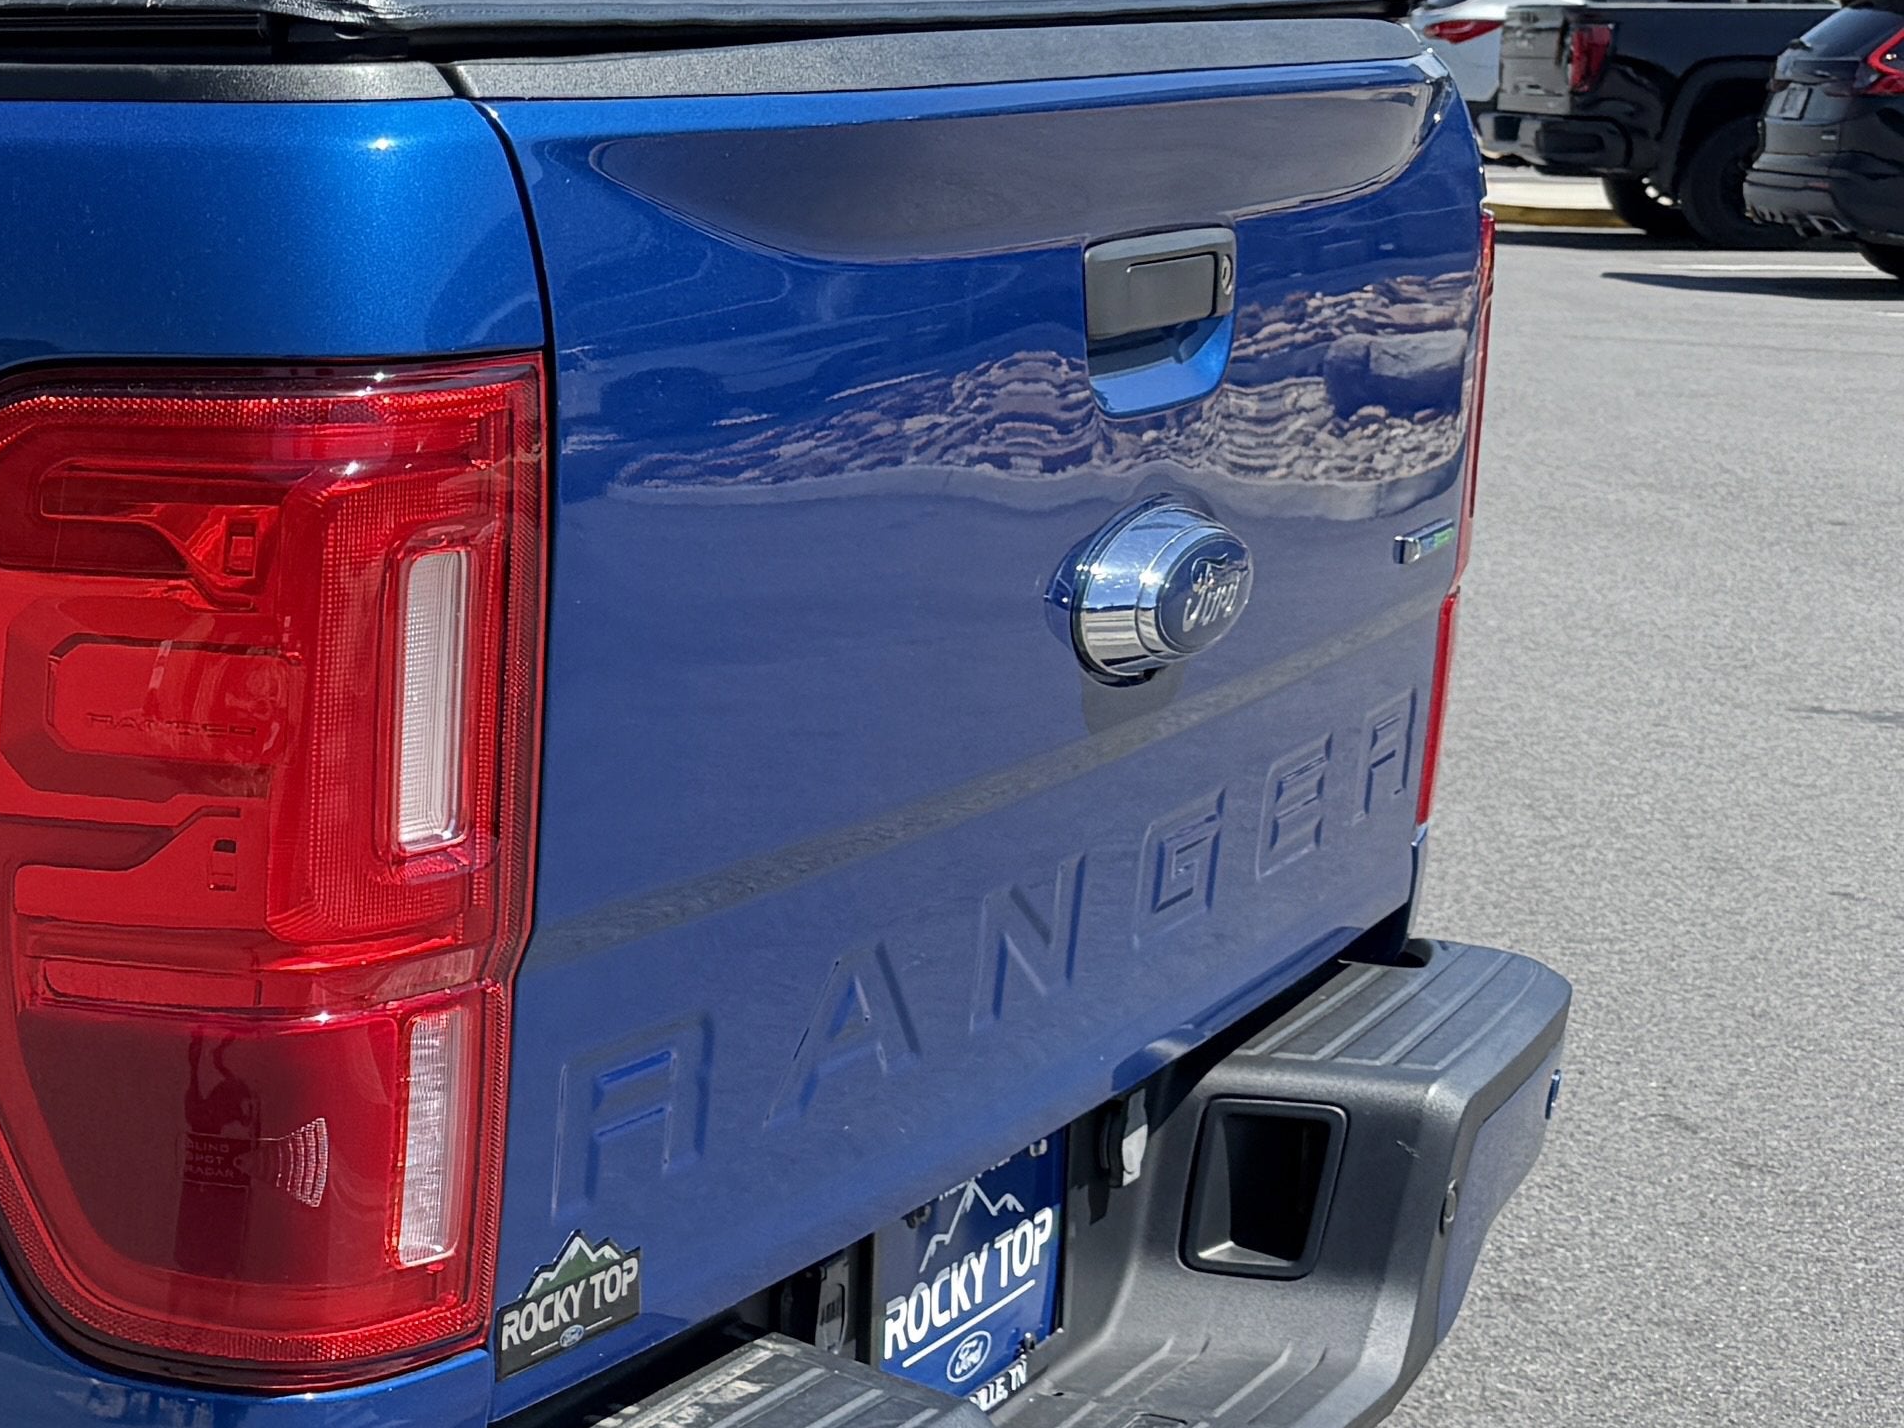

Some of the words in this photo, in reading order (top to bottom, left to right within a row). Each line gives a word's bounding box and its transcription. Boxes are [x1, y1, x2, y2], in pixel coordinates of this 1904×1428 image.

[1182, 552, 1242, 633] Ford
[551, 686, 1419, 1227] RANGER
[501, 1279, 586, 1351] ROCKY
[589, 1257, 639, 1310] TOP
[883, 1241, 989, 1360] ROCKY
[994, 1206, 1053, 1288] TOP
